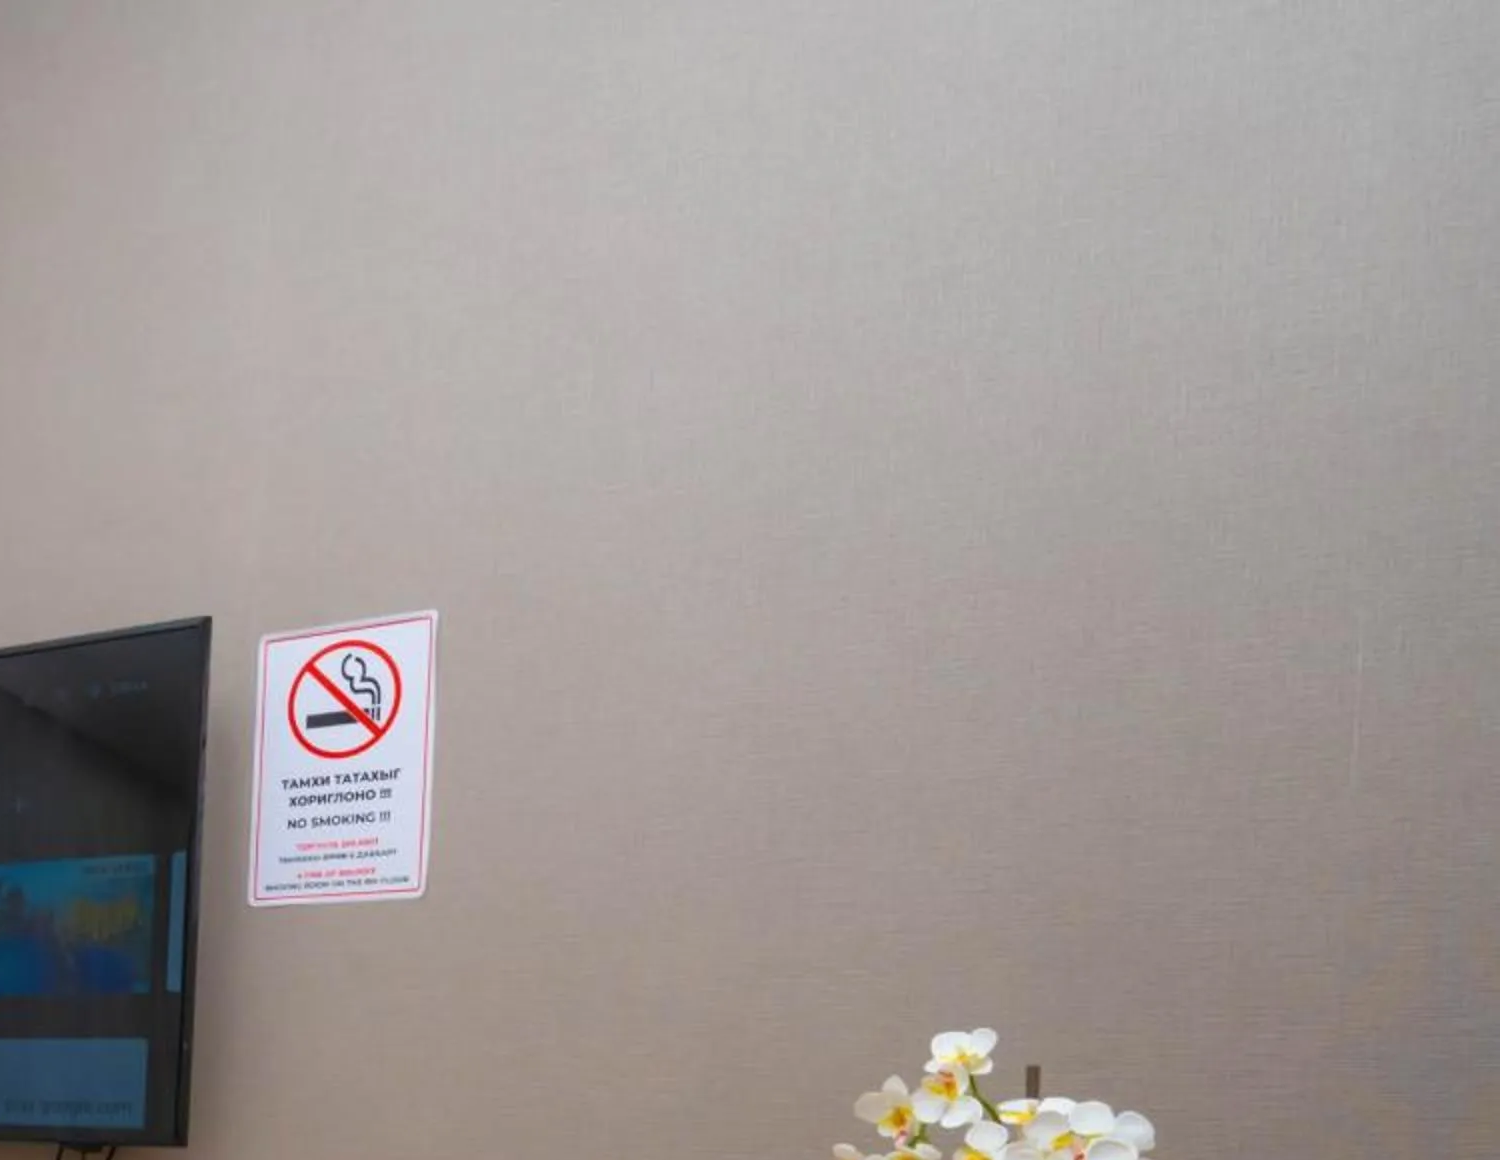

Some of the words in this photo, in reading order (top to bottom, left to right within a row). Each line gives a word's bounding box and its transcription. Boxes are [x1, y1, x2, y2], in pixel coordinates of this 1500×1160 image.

[281, 775, 330, 790] ТАМХИ
[334, 768, 401, 785] ТАТАХЫГ
[288, 789, 376, 807] ХОРИГЛОНО
[287, 818, 307, 830] NO
[311, 811, 376, 829] SMOKING
